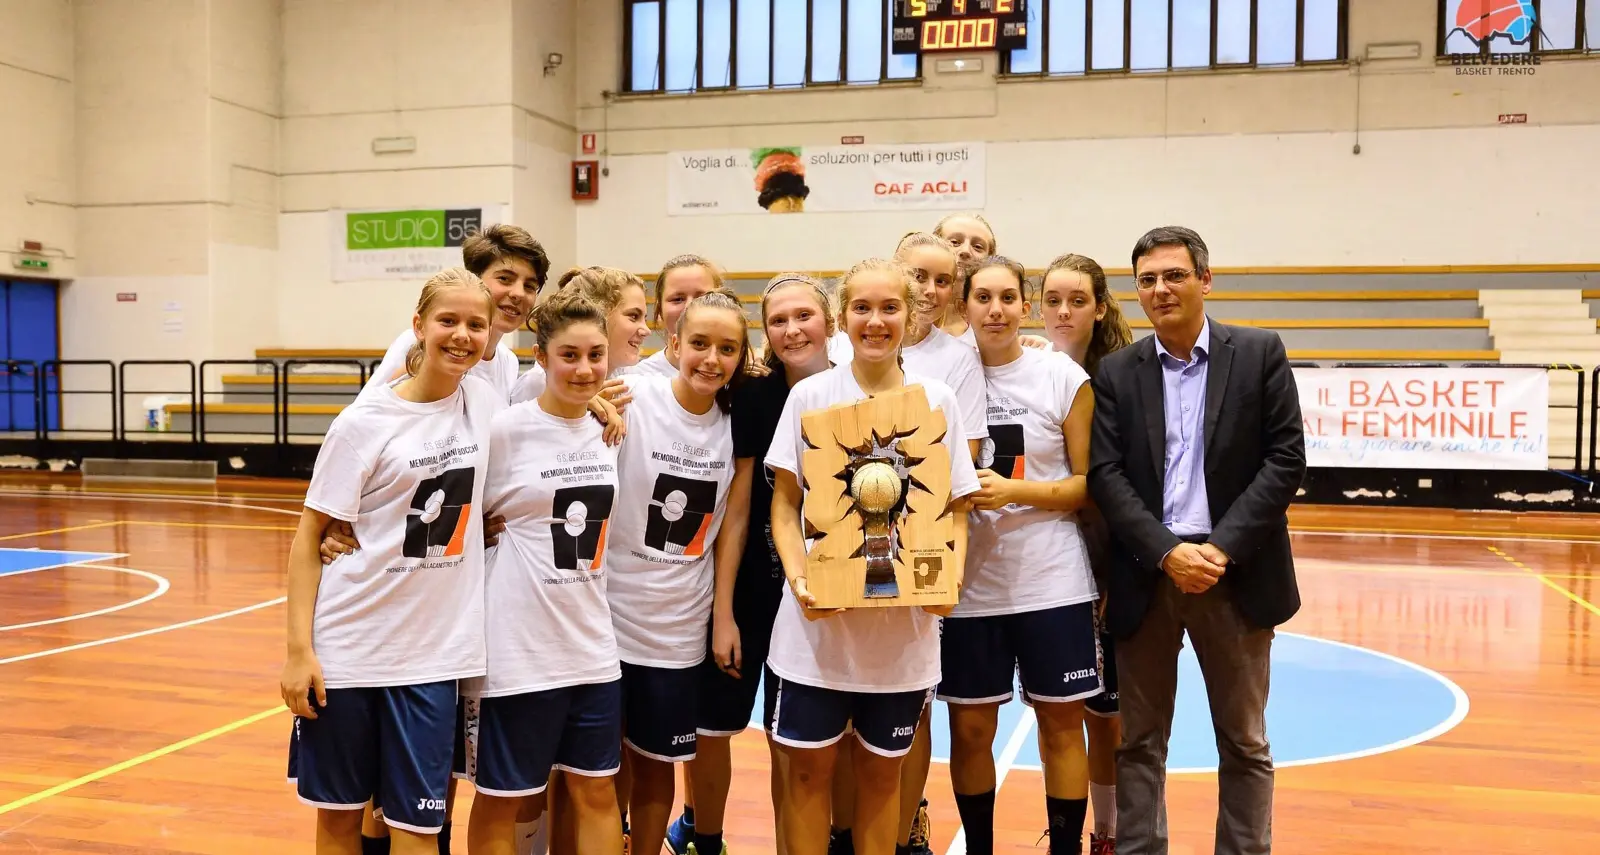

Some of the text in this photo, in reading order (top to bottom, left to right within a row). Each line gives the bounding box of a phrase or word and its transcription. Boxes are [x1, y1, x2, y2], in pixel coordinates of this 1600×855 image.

[682, 155, 722, 172] Voglia
[724, 155, 748, 169] di...
[810, 149, 870, 165] soluzioni
[873, 150, 896, 166] per
[899, 148, 924, 163] tutti
[935, 148, 970, 164] gusti
[874, 181, 967, 195] CAF ACLI
[352, 217, 479, 243] STUDIO 55
[1318, 380, 1505, 408] IL BASKET
[1341, 411, 1529, 439] FEMMINILE
[409, 455, 439, 469] MEMORIAL
[457, 444, 479, 456] BOCCHI
[568, 450, 600, 462] BELVEDERE
[683, 443, 712, 458] BELVEDERE
[651, 451, 726, 470] MEMORIAL GIOVANNI BOCCHI
[540, 466, 573, 480] MEMORIAL
[573, 464, 599, 475] GIOVANNI
[1063, 667, 1097, 683] Joma
[671, 732, 697, 746] Jom
